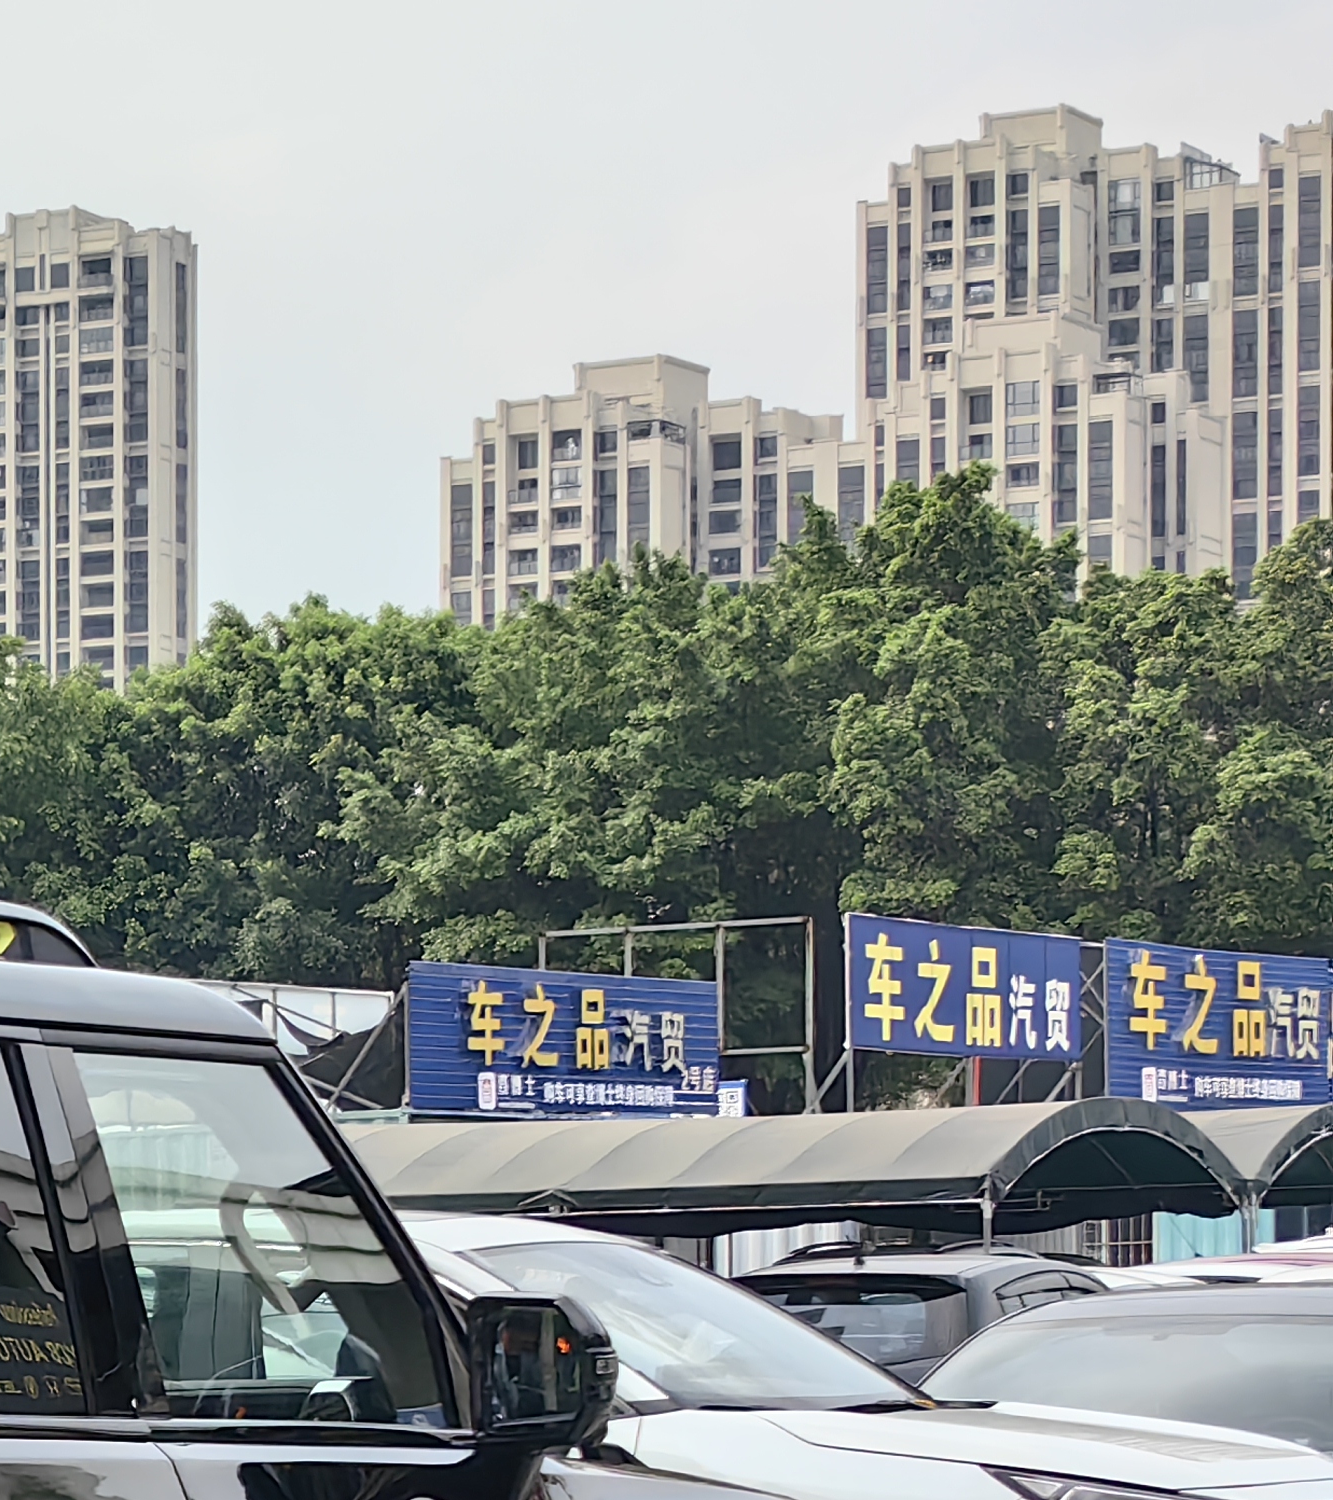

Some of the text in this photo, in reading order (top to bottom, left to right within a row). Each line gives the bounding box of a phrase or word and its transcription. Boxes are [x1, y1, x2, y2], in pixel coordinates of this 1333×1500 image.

[467, 980, 686, 1072] 车之品汽贸
[864, 933, 1071, 1052] 车之品汽贸
[1129, 949, 1320, 1059] 车之品汽贸
